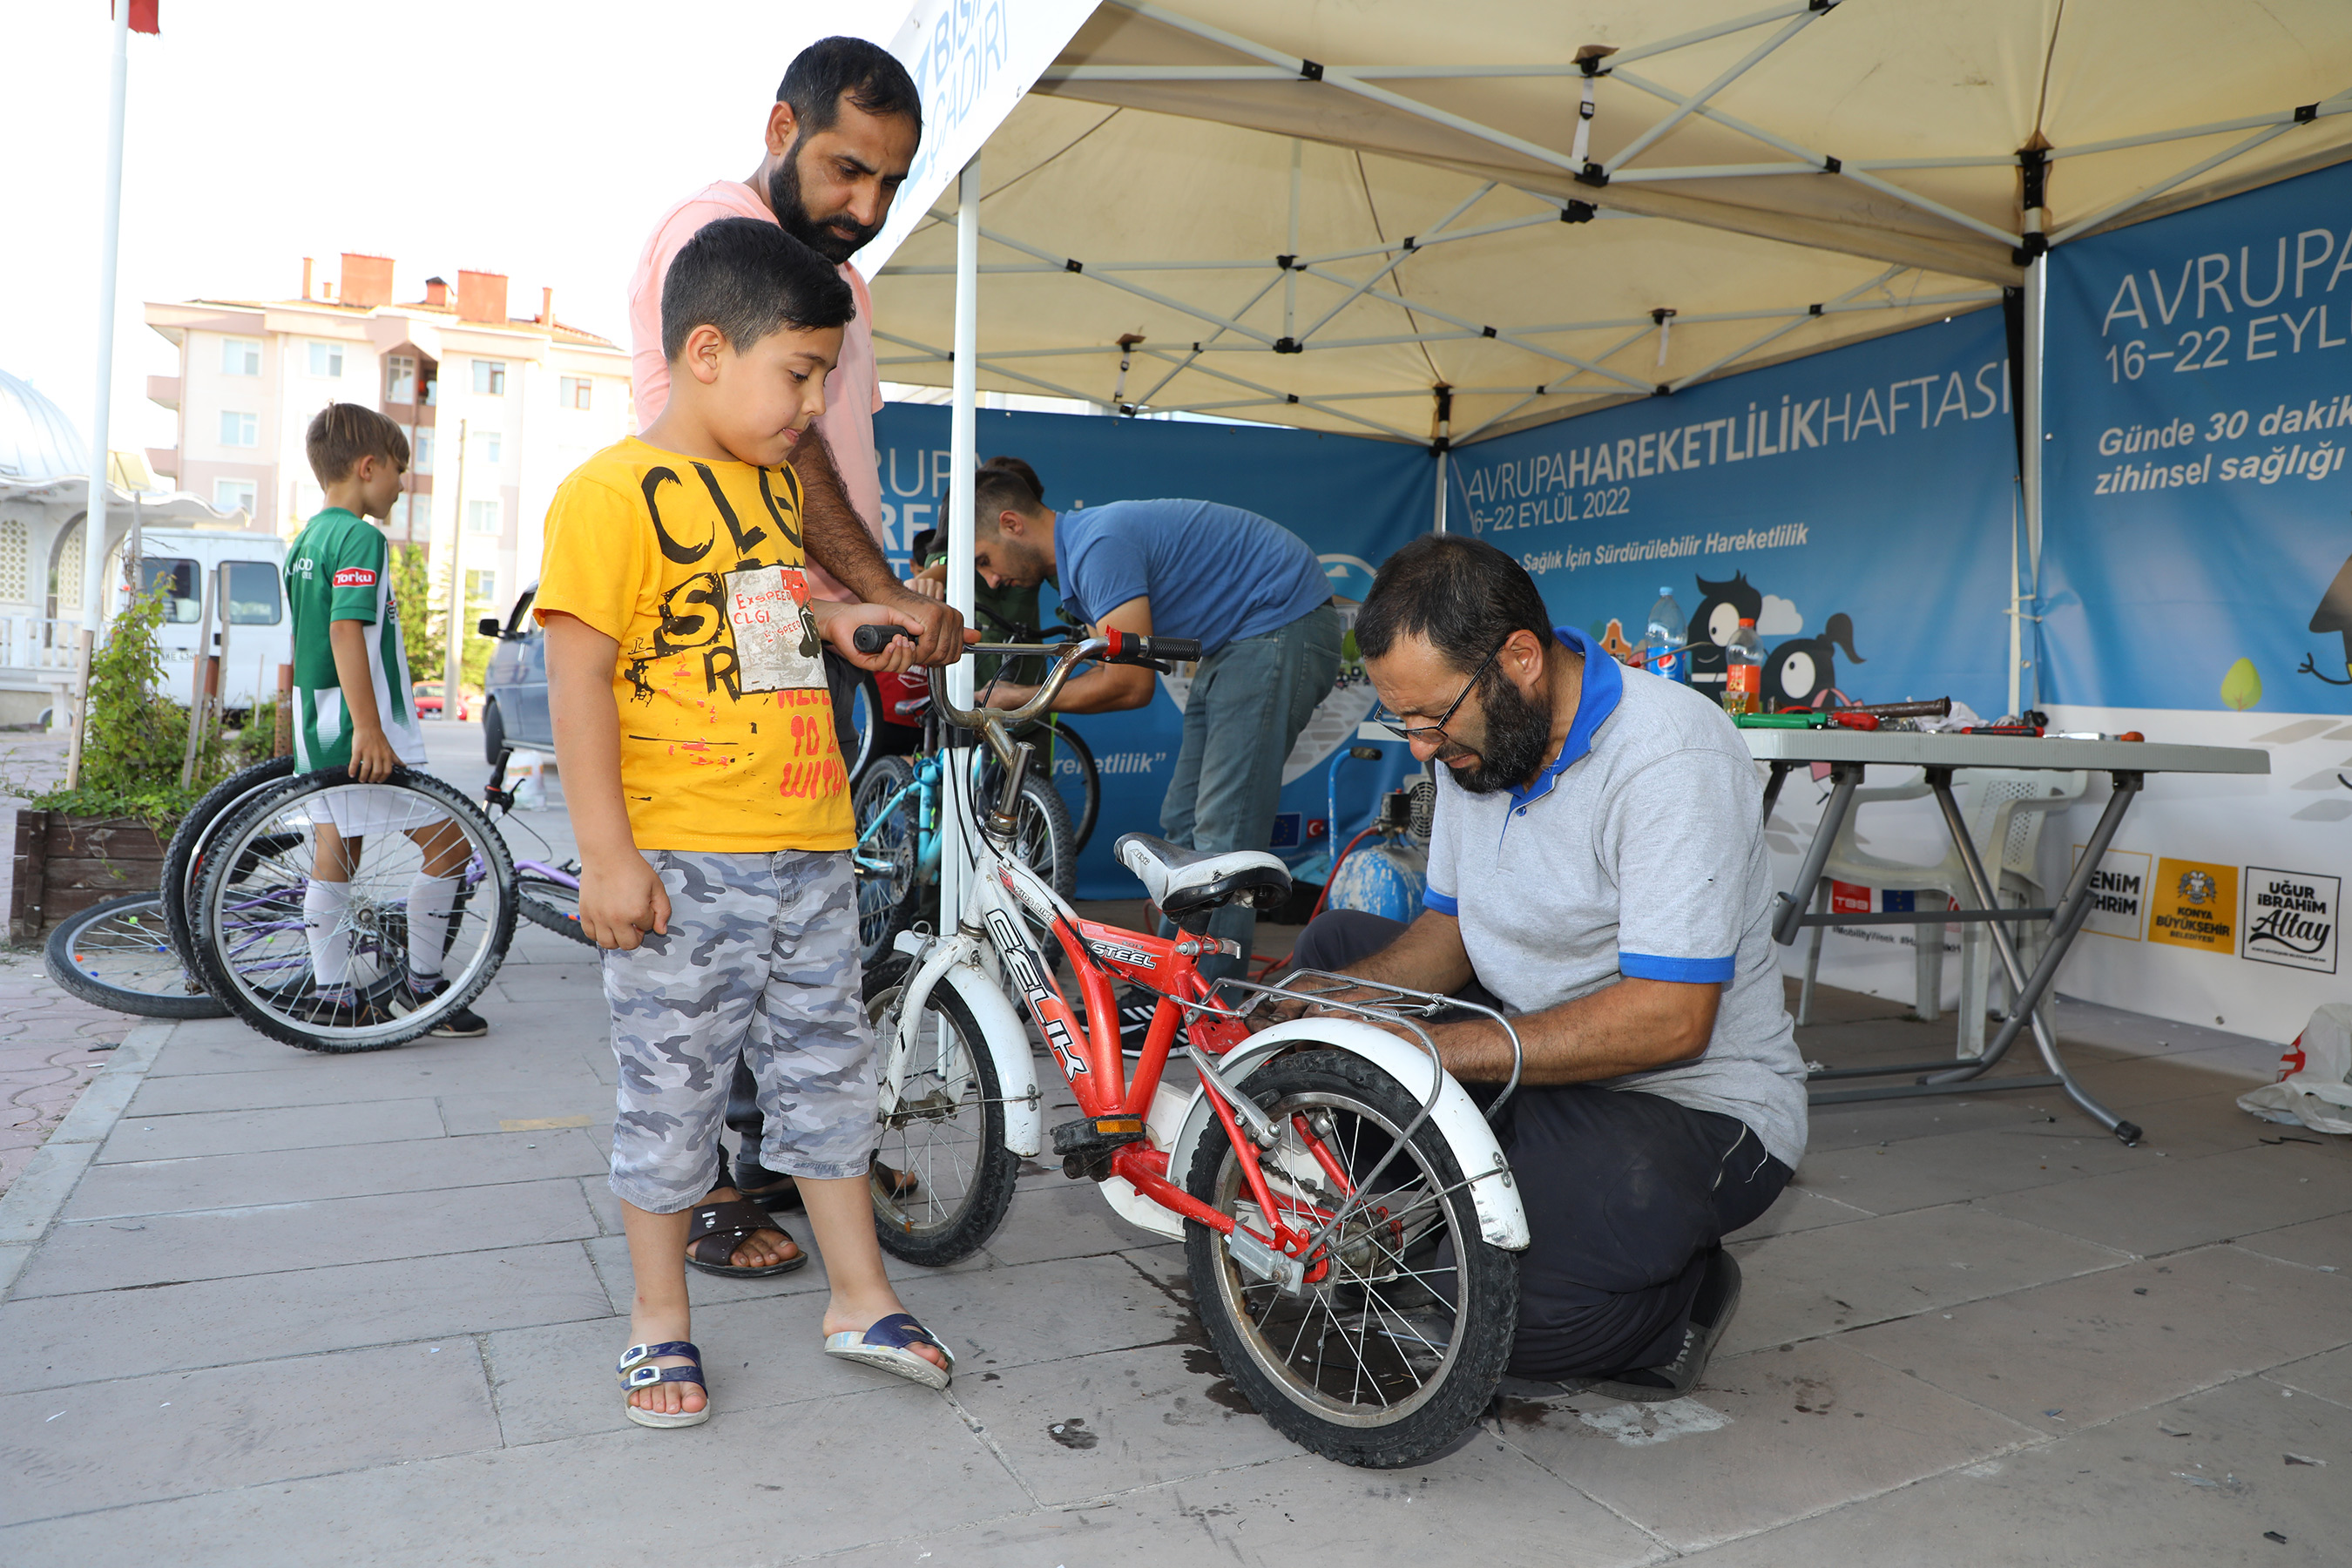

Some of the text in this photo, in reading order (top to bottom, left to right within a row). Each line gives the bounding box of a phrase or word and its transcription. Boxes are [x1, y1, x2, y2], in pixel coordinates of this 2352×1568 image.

[2245, 303, 2352, 362] EYL
[2099, 418, 2195, 457] Günde
[2205, 409, 2249, 443] 30
[2094, 440, 2346, 495] zihinsel sağlığı
[1519, 492, 1578, 528] EYLÜL
[1583, 486, 1631, 519] 2022
[1524, 523, 1809, 575] Sağlık İçin Sürdürülebilir Hareketlilik
[335, 571, 372, 584] Torku
[733, 610, 770, 625] CLGI
[1014, 884, 1057, 924] KIDS BIKE
[2269, 880, 2315, 899] UĞUR
[2155, 915, 2230, 936] BÜYÜKŞEHİR
[2177, 907, 2213, 920] KONYA
[2249, 909, 2331, 954] Altay
[1091, 942, 1157, 970] STEEL
